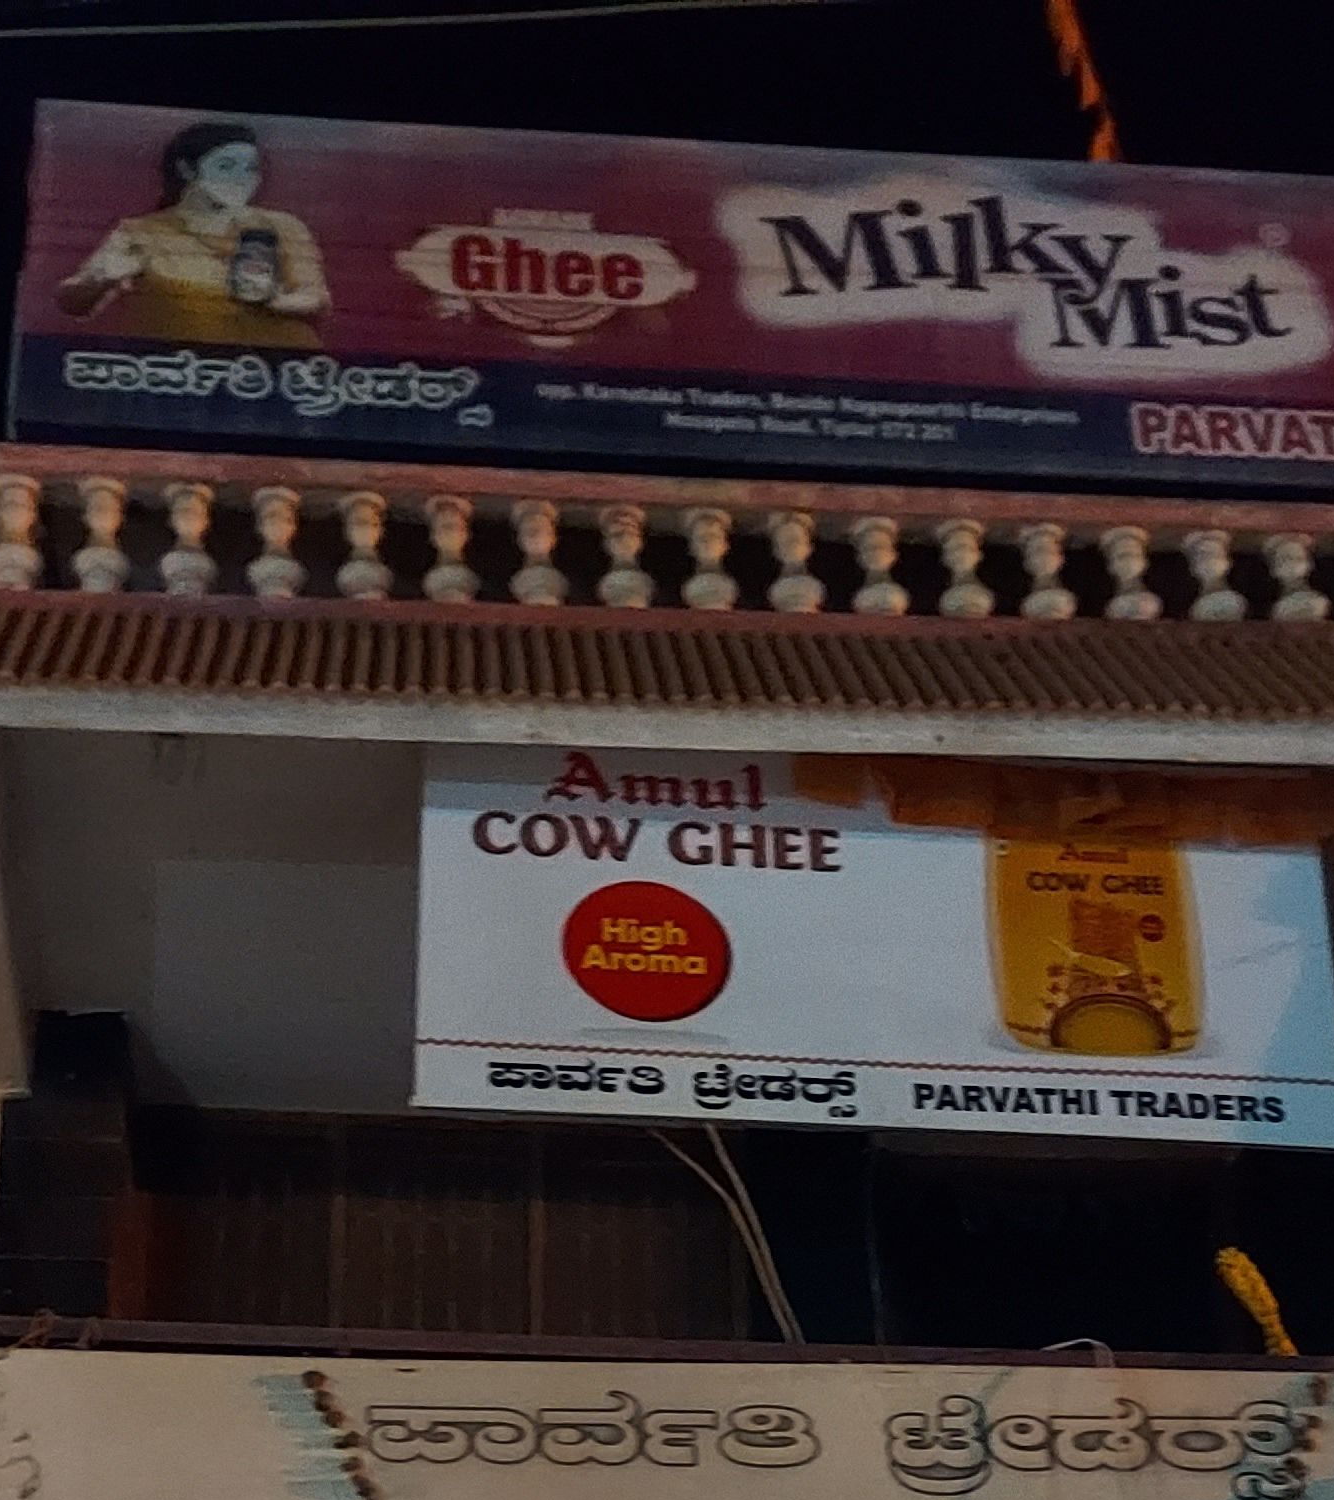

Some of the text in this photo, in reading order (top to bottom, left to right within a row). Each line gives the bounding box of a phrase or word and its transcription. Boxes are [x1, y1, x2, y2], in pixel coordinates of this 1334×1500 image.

[451, 234, 645, 300] Ghee
[760, 195, 1134, 304] Milky
[1039, 265, 1293, 348] Mist
[544, 750, 768, 811] Amul
[471, 811, 844, 872] COW GHEE
[1026, 871, 1165, 896] COW GHEE
[580, 943, 708, 976] Aroma
[599, 917, 688, 951] High
[487, 1059, 666, 1096] ಪಾರ್ವತಿ
[913, 1082, 1286, 1124] PARVATHI TRADERS
[365, 1390, 823, 1469] ಪಾರ್ವತಿ
